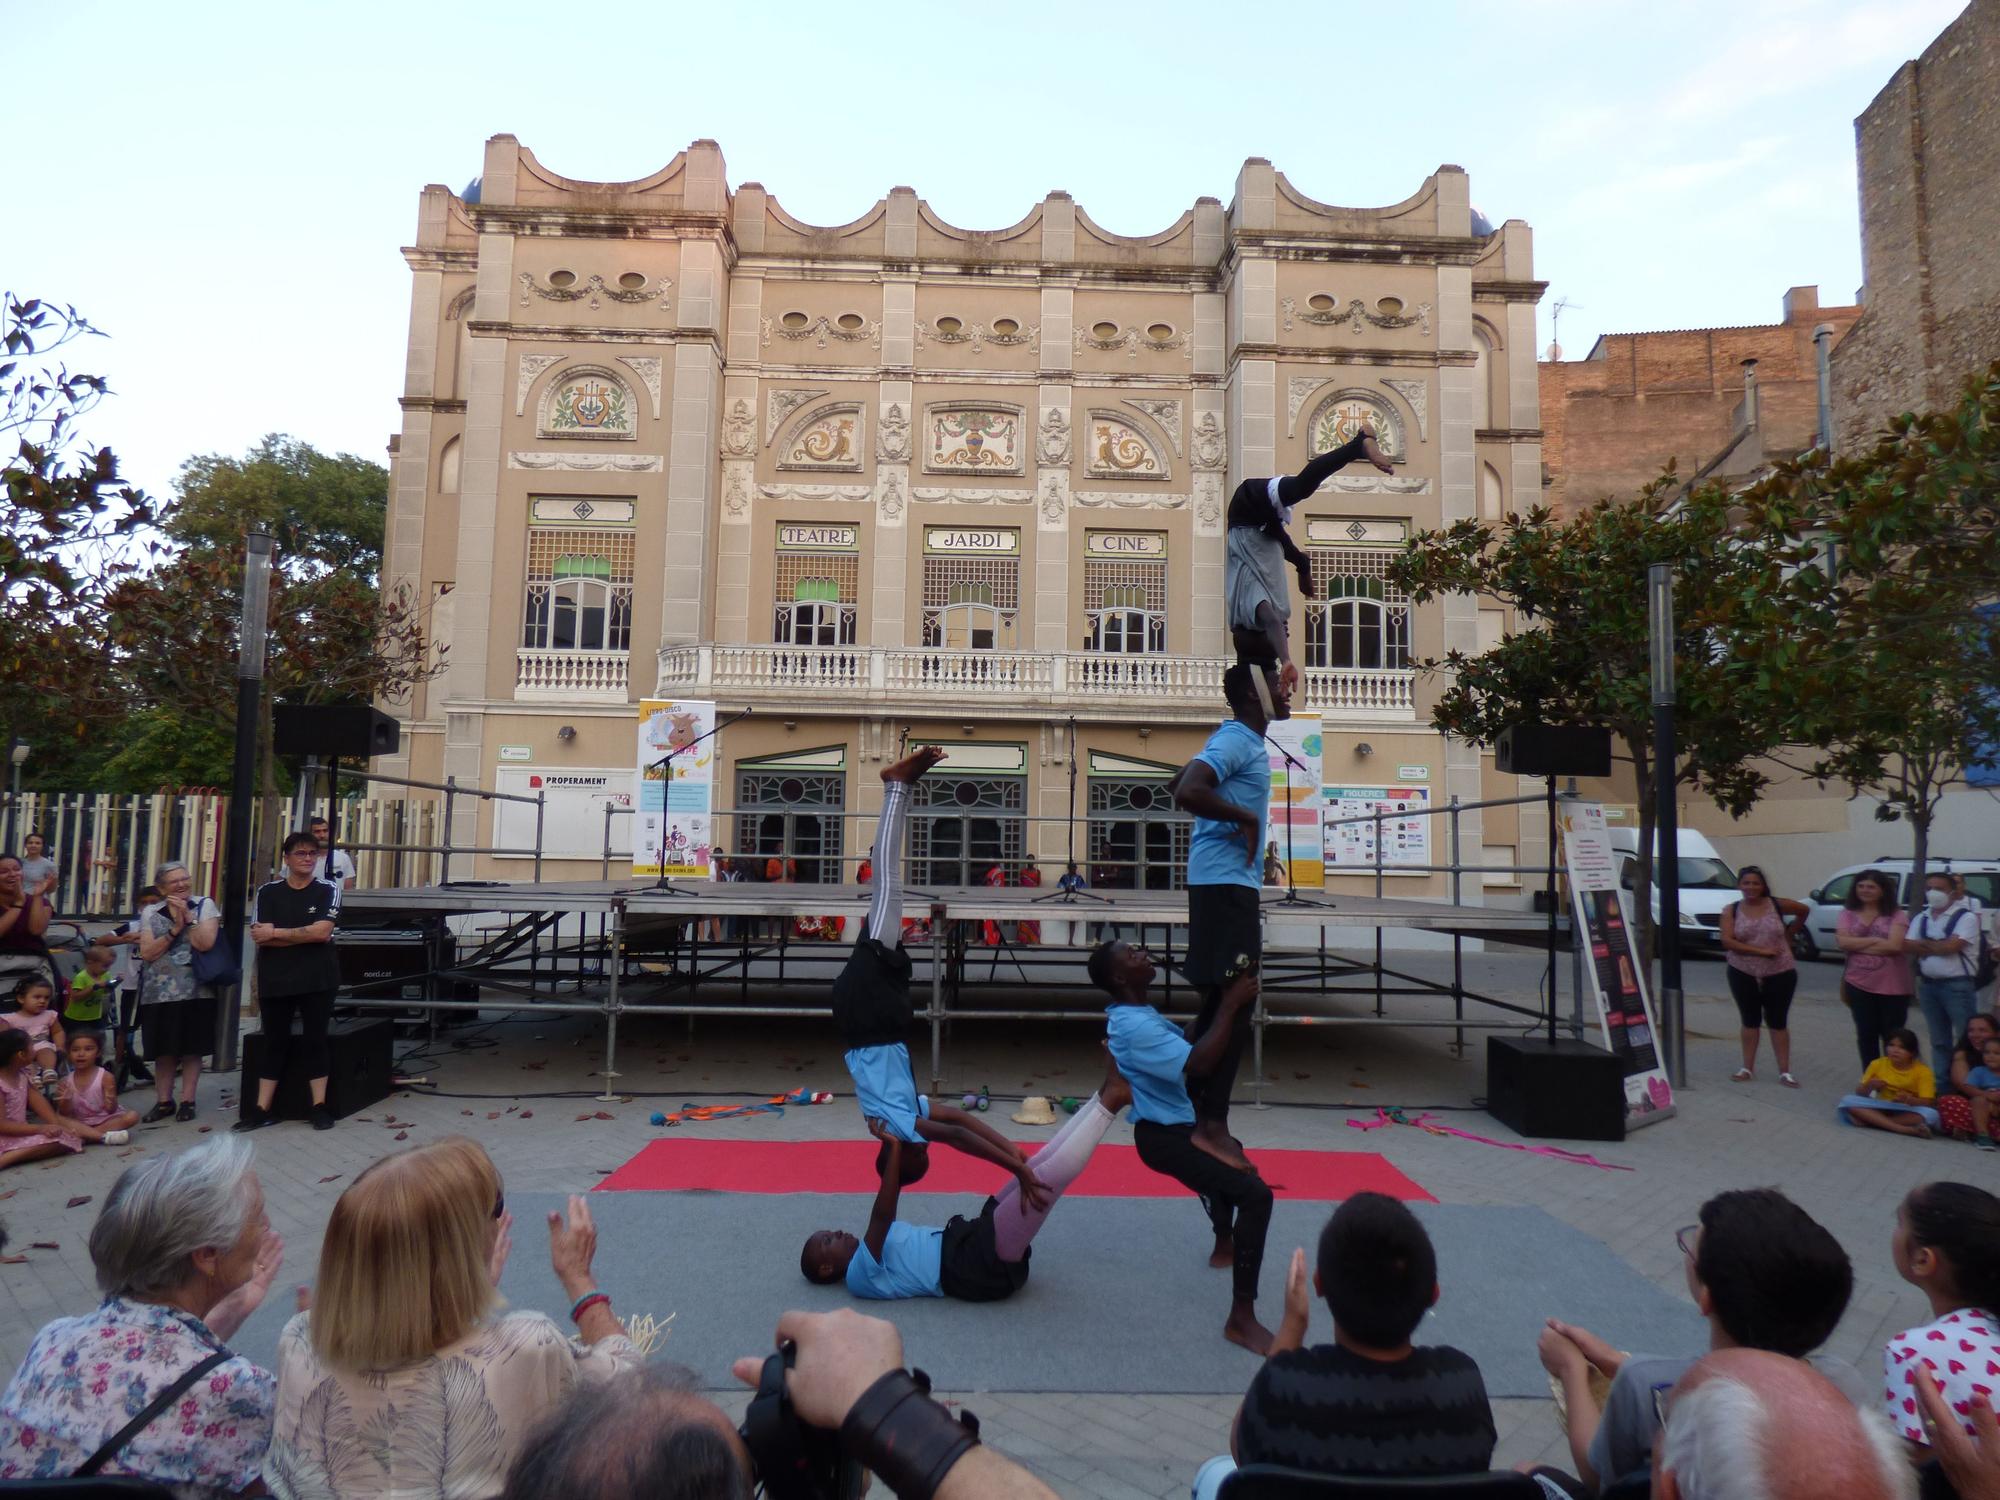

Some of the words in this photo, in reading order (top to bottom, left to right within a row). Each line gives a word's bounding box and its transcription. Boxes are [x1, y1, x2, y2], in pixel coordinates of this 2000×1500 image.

[785, 527, 852, 544] TEATRE
[943, 531, 1003, 549] JARDÍ
[1102, 536, 1149, 551] CINE
[545, 776, 607, 785] PROPERAMENT
[363, 970, 393, 978] nord.cat
